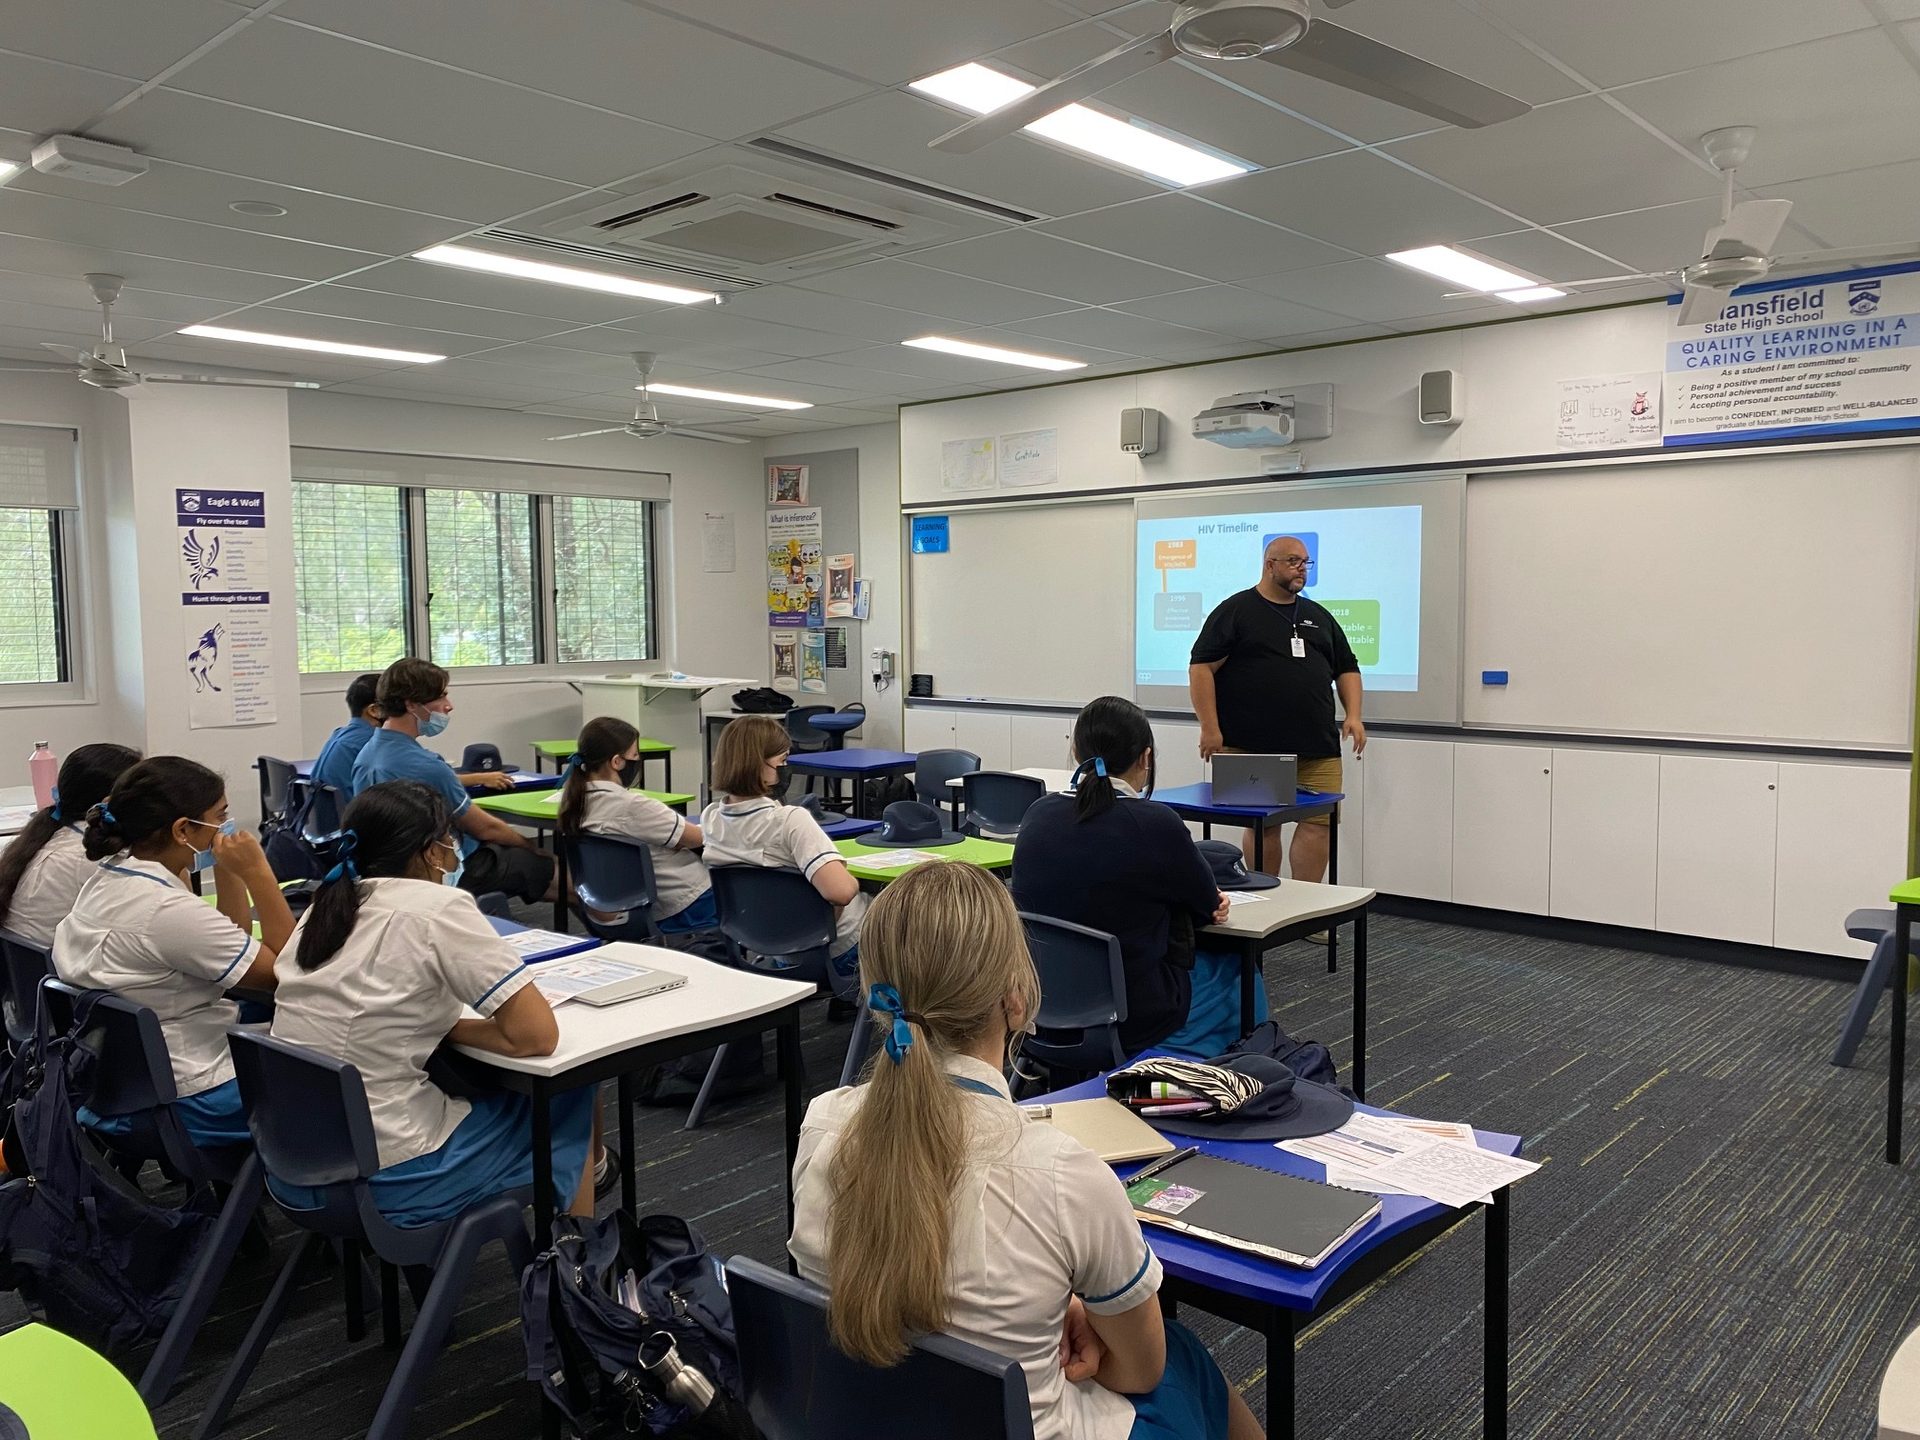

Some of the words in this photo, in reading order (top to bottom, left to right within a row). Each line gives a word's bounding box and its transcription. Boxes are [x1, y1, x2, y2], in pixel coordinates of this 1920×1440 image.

[1720, 288, 1825, 320] ansfield
[1704, 322, 1737, 334] State
[1741, 316, 1772, 330] High
[1776, 310, 1824, 325] School
[1682, 335, 1754, 355] QUALITY
[1763, 323, 1856, 346] LEARNING
[1866, 320, 1885, 334] IN
[1895, 318, 1907, 330] A
[1686, 350, 1756, 369] CARING
[1765, 333, 1902, 360] ENVIRONMENT
[1742, 363, 1775, 374] student
[1797, 357, 1847, 369] committed
[1690, 384, 1715, 393] Being
[1723, 378, 1758, 390] positive
[1759, 375, 1796, 385] member
[1797, 373, 1809, 381] of
[1808, 372, 1823, 381] my
[1824, 368, 1857, 378] school
[1858, 363, 1912, 375] community
[1689, 401, 1732, 411] Accepting
[1733, 396, 1772, 407] personal
[1773, 390, 1839, 402] accountability.
[1690, 391, 1728, 401] Personal
[1728, 386, 1784, 397] achievement
[1785, 383, 1803, 391] and
[1804, 380, 1842, 389] success
[1696, 414, 1724, 423] become
[1781, 405, 1825, 416] INFORMED
[1842, 397, 1919, 410] WELL-BALANCED
[1716, 420, 1747, 430] graduate
[1757, 415, 1791, 425] Mansfield
[1814, 412, 1832, 421] High
[207, 498, 230, 507] Eagle
[231, 498, 239, 506] &
[240, 498, 260, 507] Wolf
[1198, 524, 1215, 534] HIV
[1217, 522, 1259, 534] Timeline
[1331, 608, 1350, 616] 2018
[1342, 623, 1366, 632] table
[1347, 635, 1375, 644] ttable
